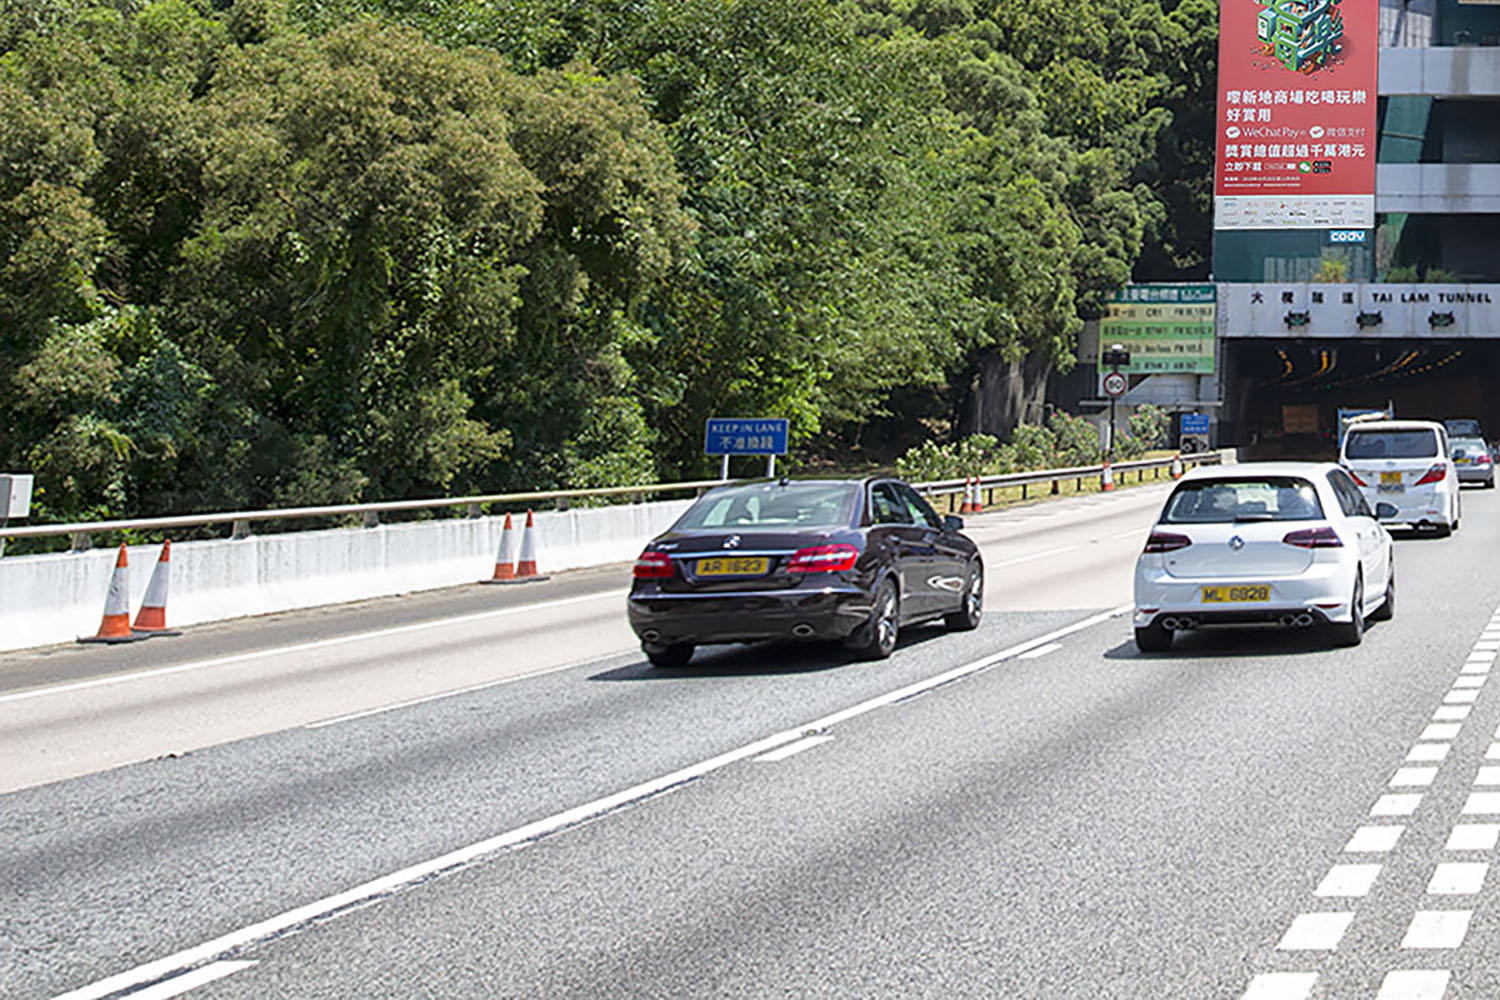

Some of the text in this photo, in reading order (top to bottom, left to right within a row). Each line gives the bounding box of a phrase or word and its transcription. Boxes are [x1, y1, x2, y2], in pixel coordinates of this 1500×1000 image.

[1226, 108, 1272, 123] 好賞用
[1242, 127, 1300, 140] WeChat Pay
[1331, 231, 1365, 242] cody
[1372, 292, 1492, 304] TAI LAM TUNNEL
[712, 424, 783, 433] KEEP IN LANE
[1203, 588, 1223, 602] ML
